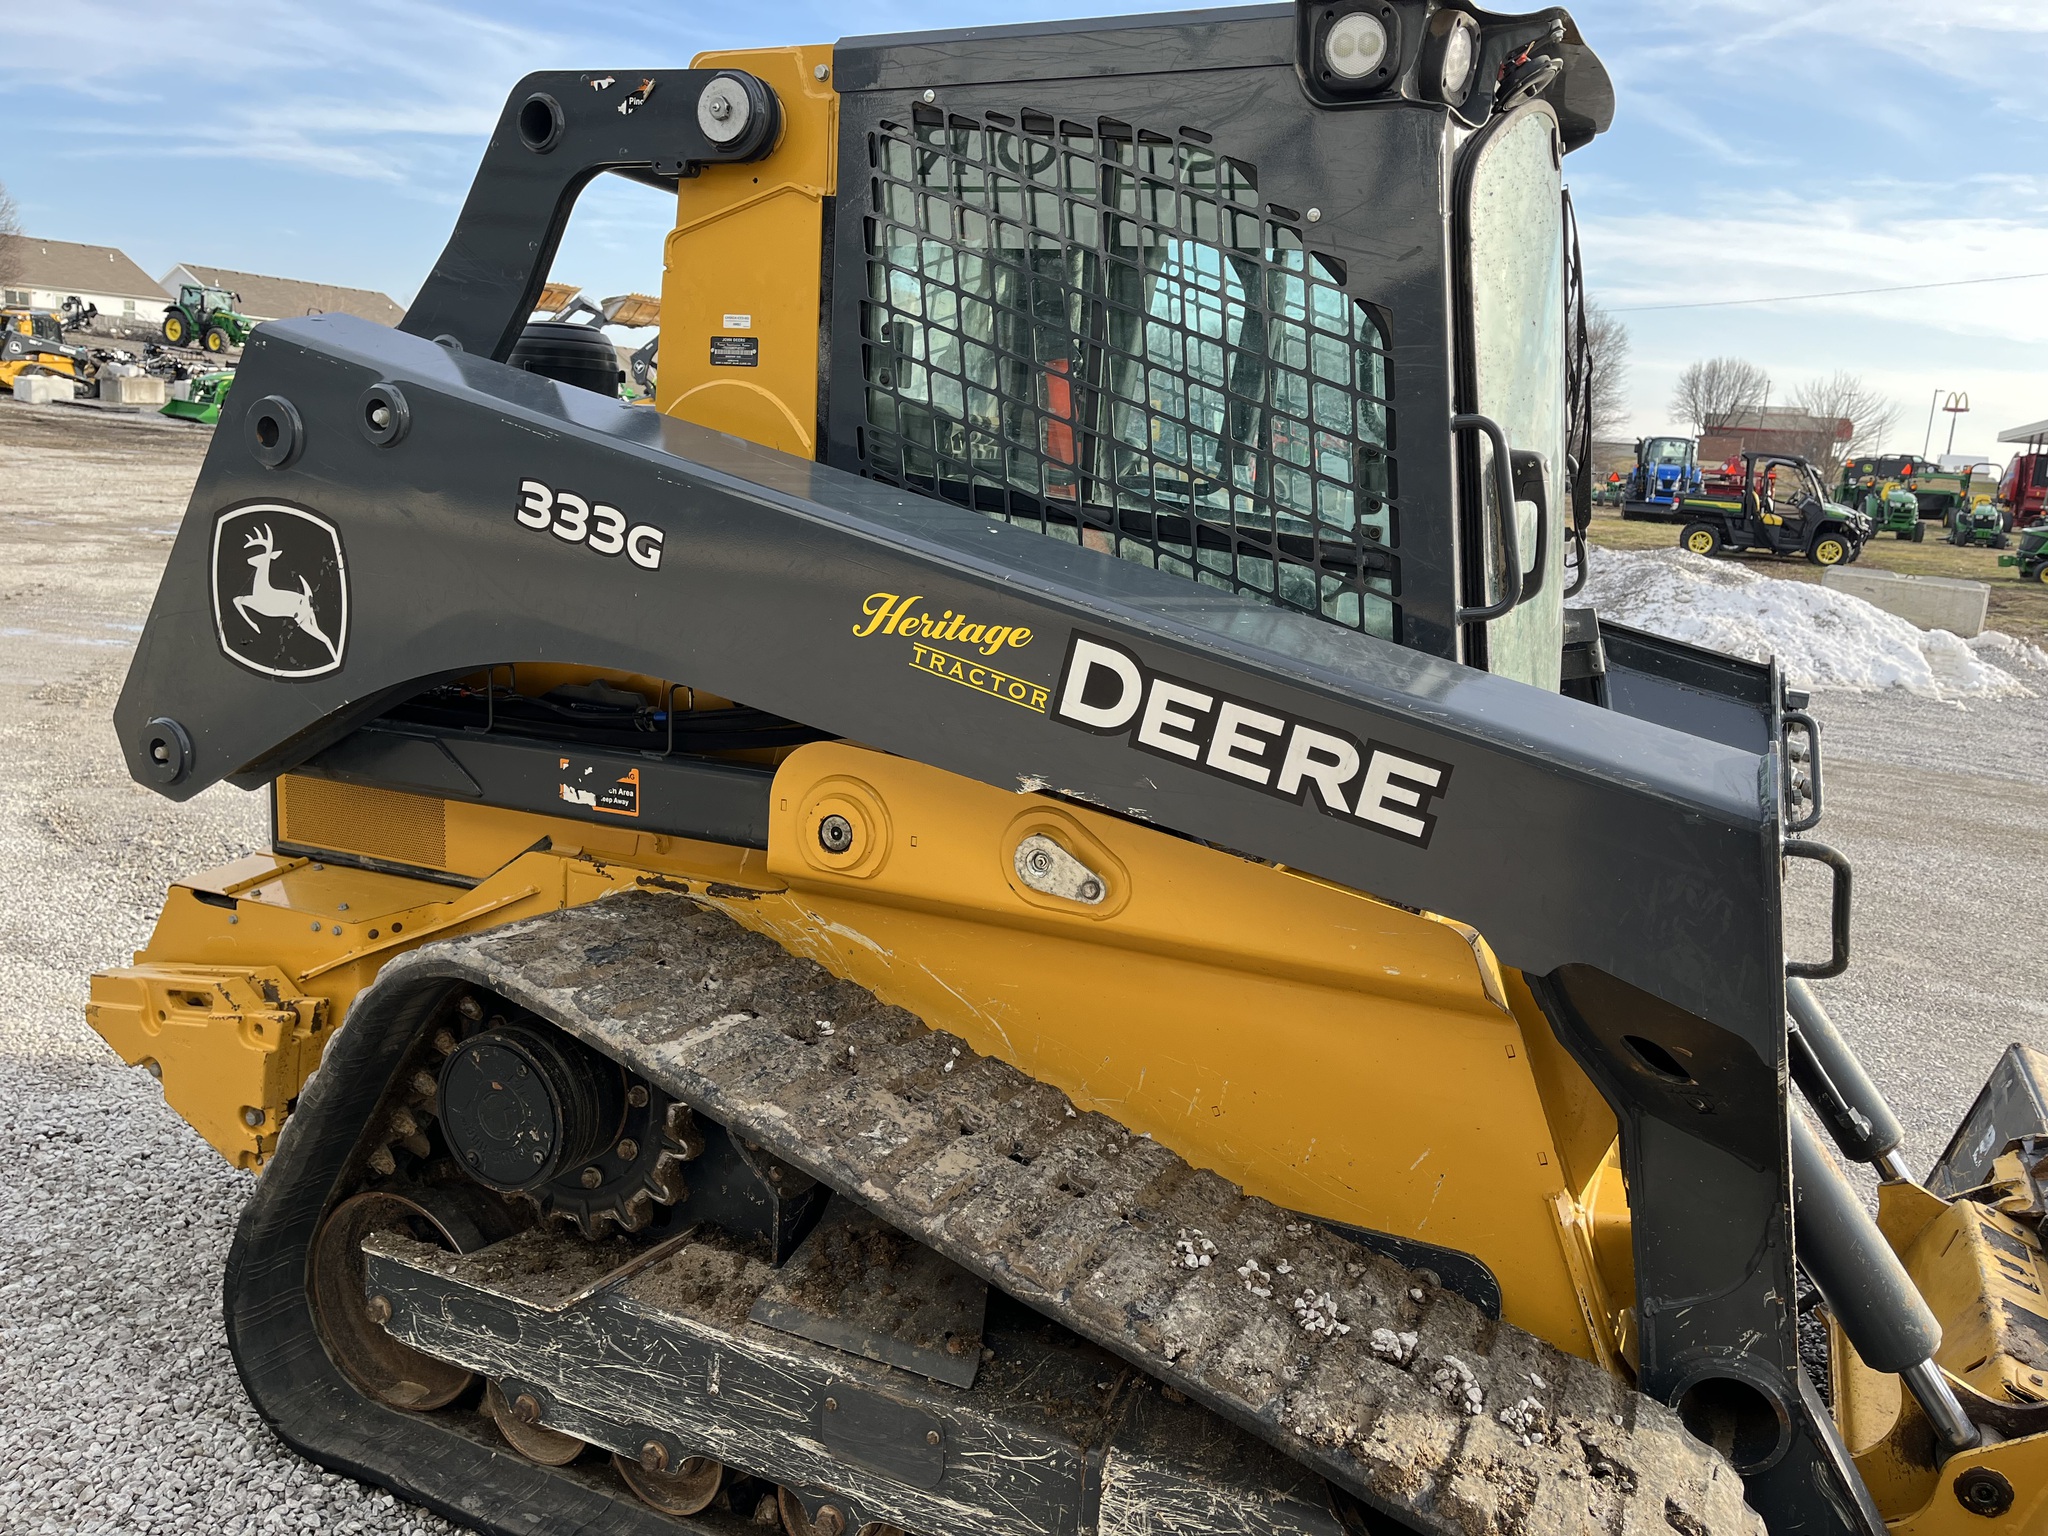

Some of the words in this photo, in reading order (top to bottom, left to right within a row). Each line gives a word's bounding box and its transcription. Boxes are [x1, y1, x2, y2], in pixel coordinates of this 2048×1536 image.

[629, 97, 644, 106] Pinc
[517, 480, 664, 569] 333G
[852, 592, 1034, 656] Heritage
[913, 645, 1048, 709] TRACTOR
[1059, 638, 1442, 838] DEERE
[613, 797, 629, 806] Away
[618, 788, 634, 797] Area
